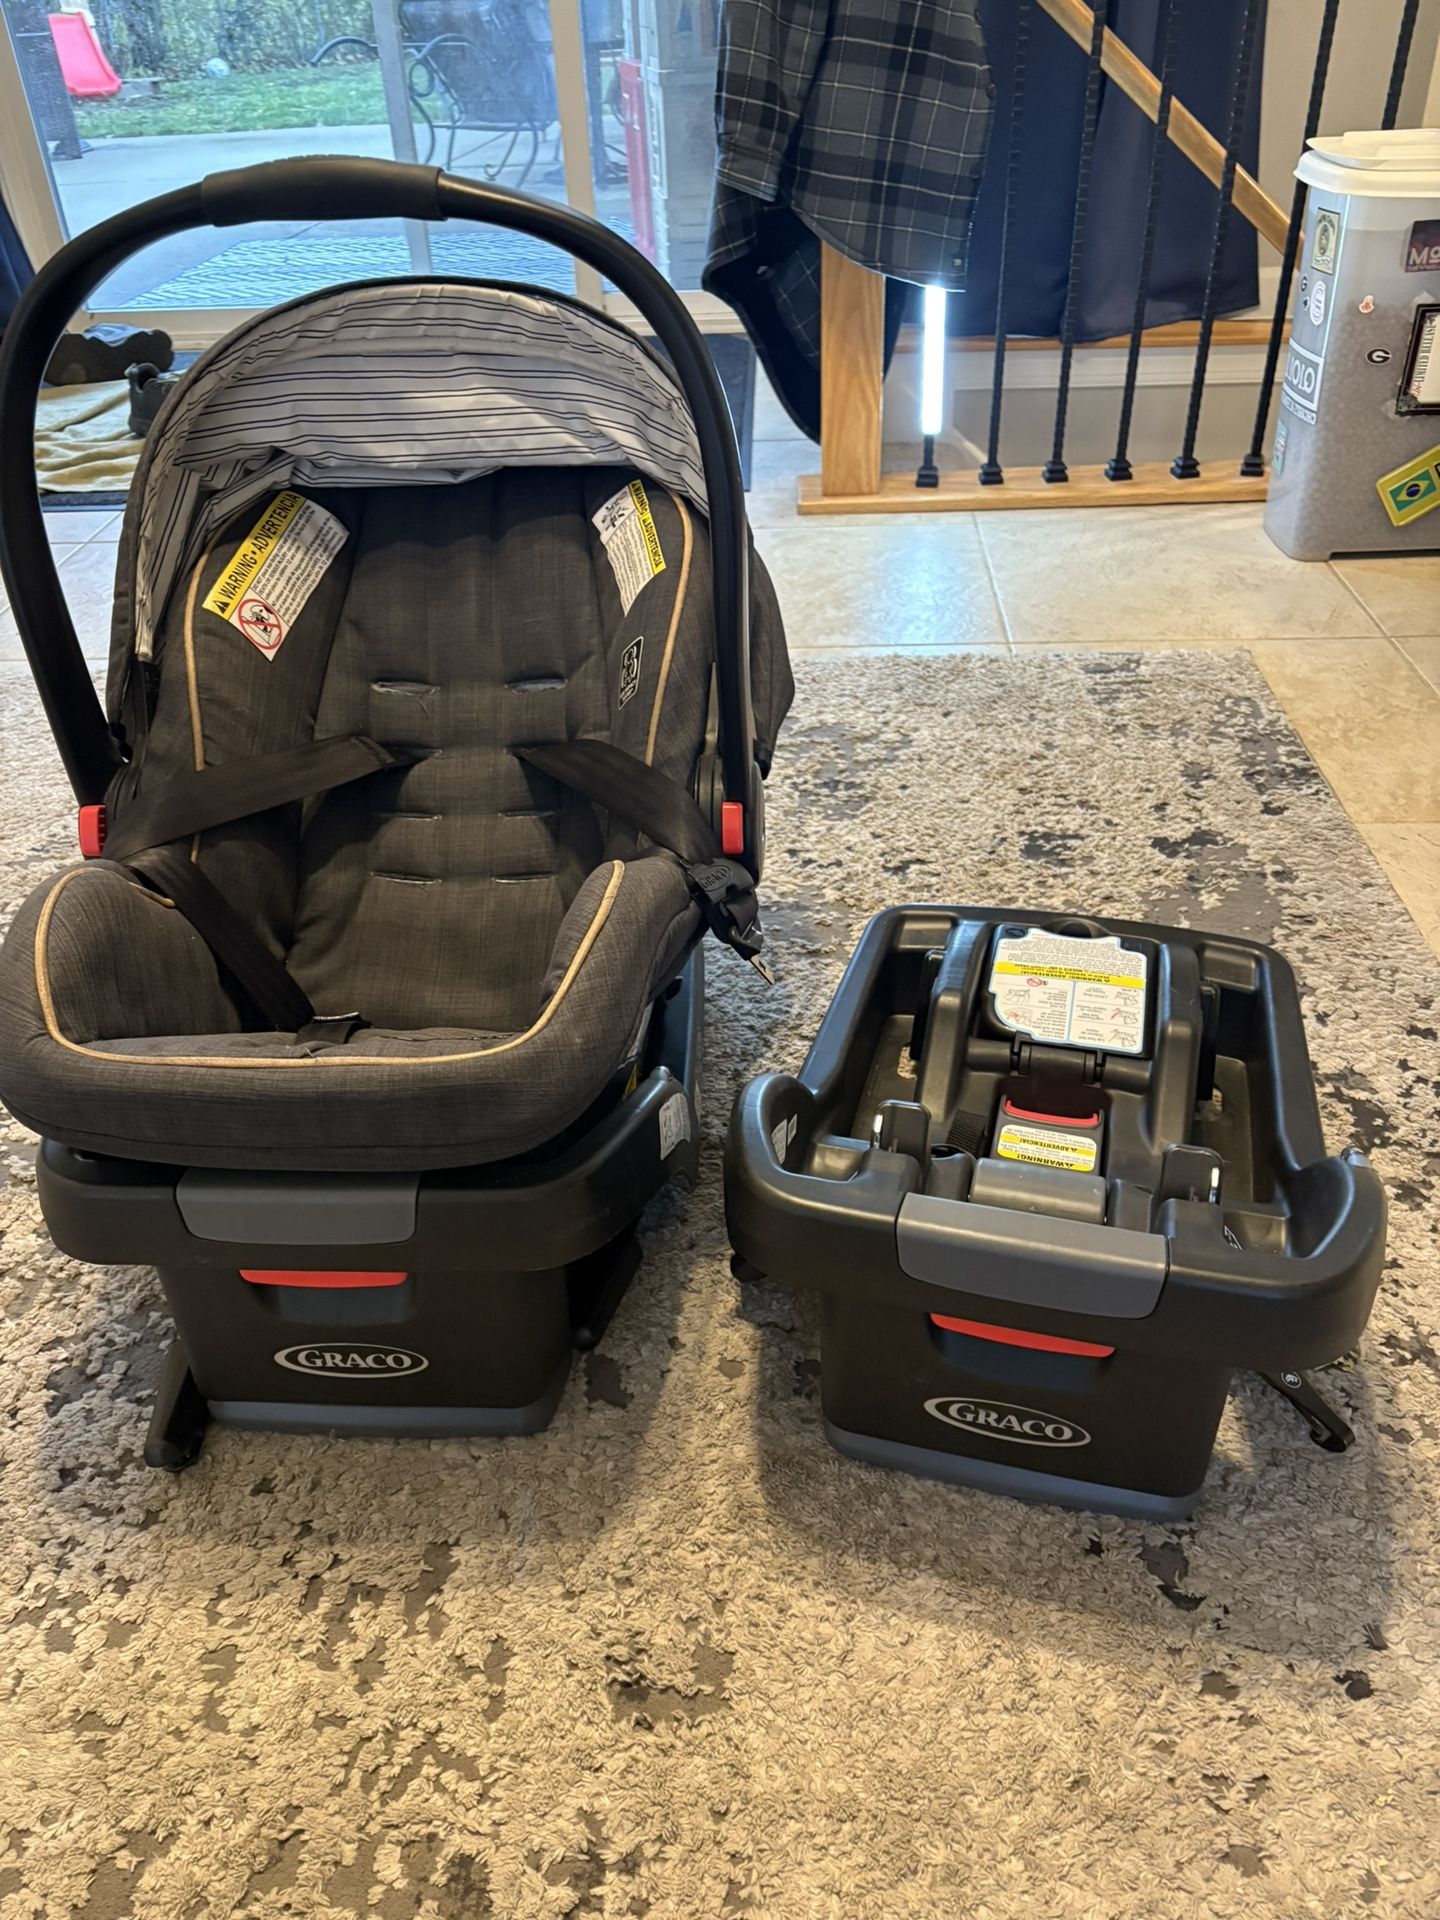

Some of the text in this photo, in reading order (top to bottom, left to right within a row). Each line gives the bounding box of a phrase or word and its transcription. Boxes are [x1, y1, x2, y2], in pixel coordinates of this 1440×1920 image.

[217, 552, 258, 600] WARNING
[253, 493, 301, 554] ADVERTENCIA
[1019, 1137, 1069, 1151] ADVERTENCIA!
[1016, 1153, 1064, 1167] WARNING!
[297, 1350, 412, 1369] GRACO
[948, 1403, 1073, 1440] GRACO
